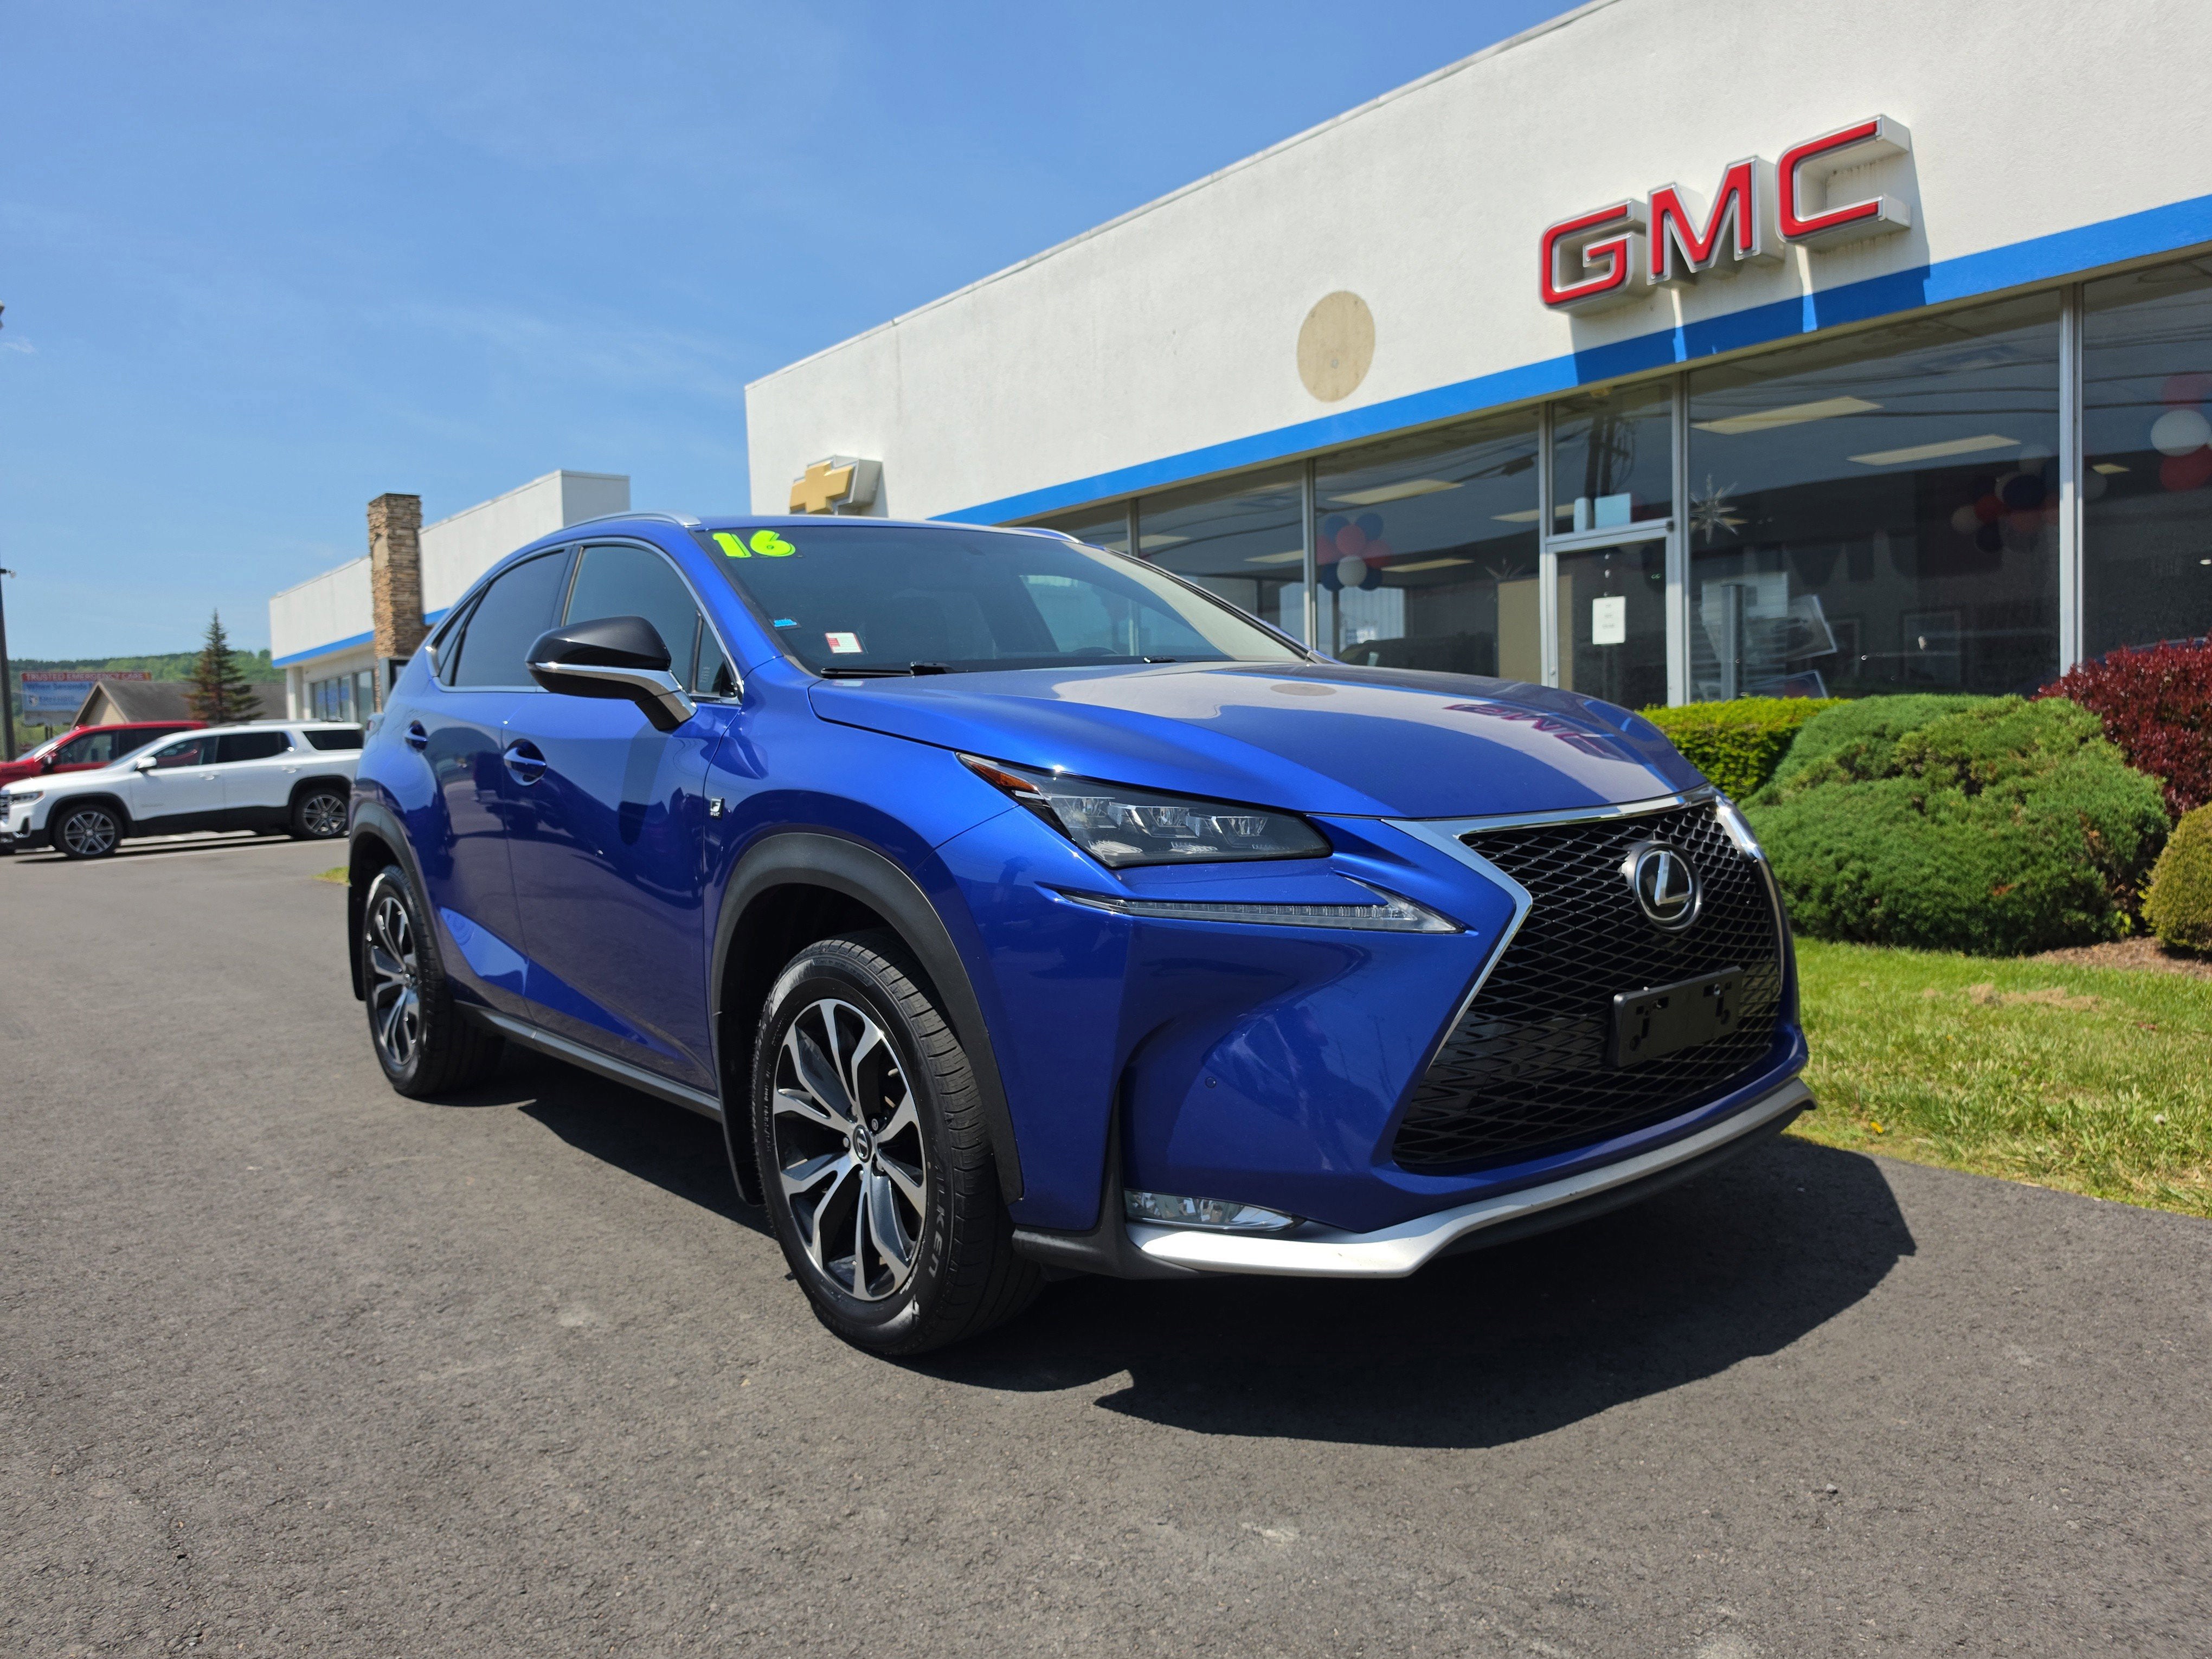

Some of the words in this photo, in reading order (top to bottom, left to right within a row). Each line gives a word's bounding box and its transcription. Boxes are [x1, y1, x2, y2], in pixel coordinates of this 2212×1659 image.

[1539, 113, 1886, 313] GMC
[712, 530, 796, 558] 16
[26, 673, 66, 681] TRUSTED
